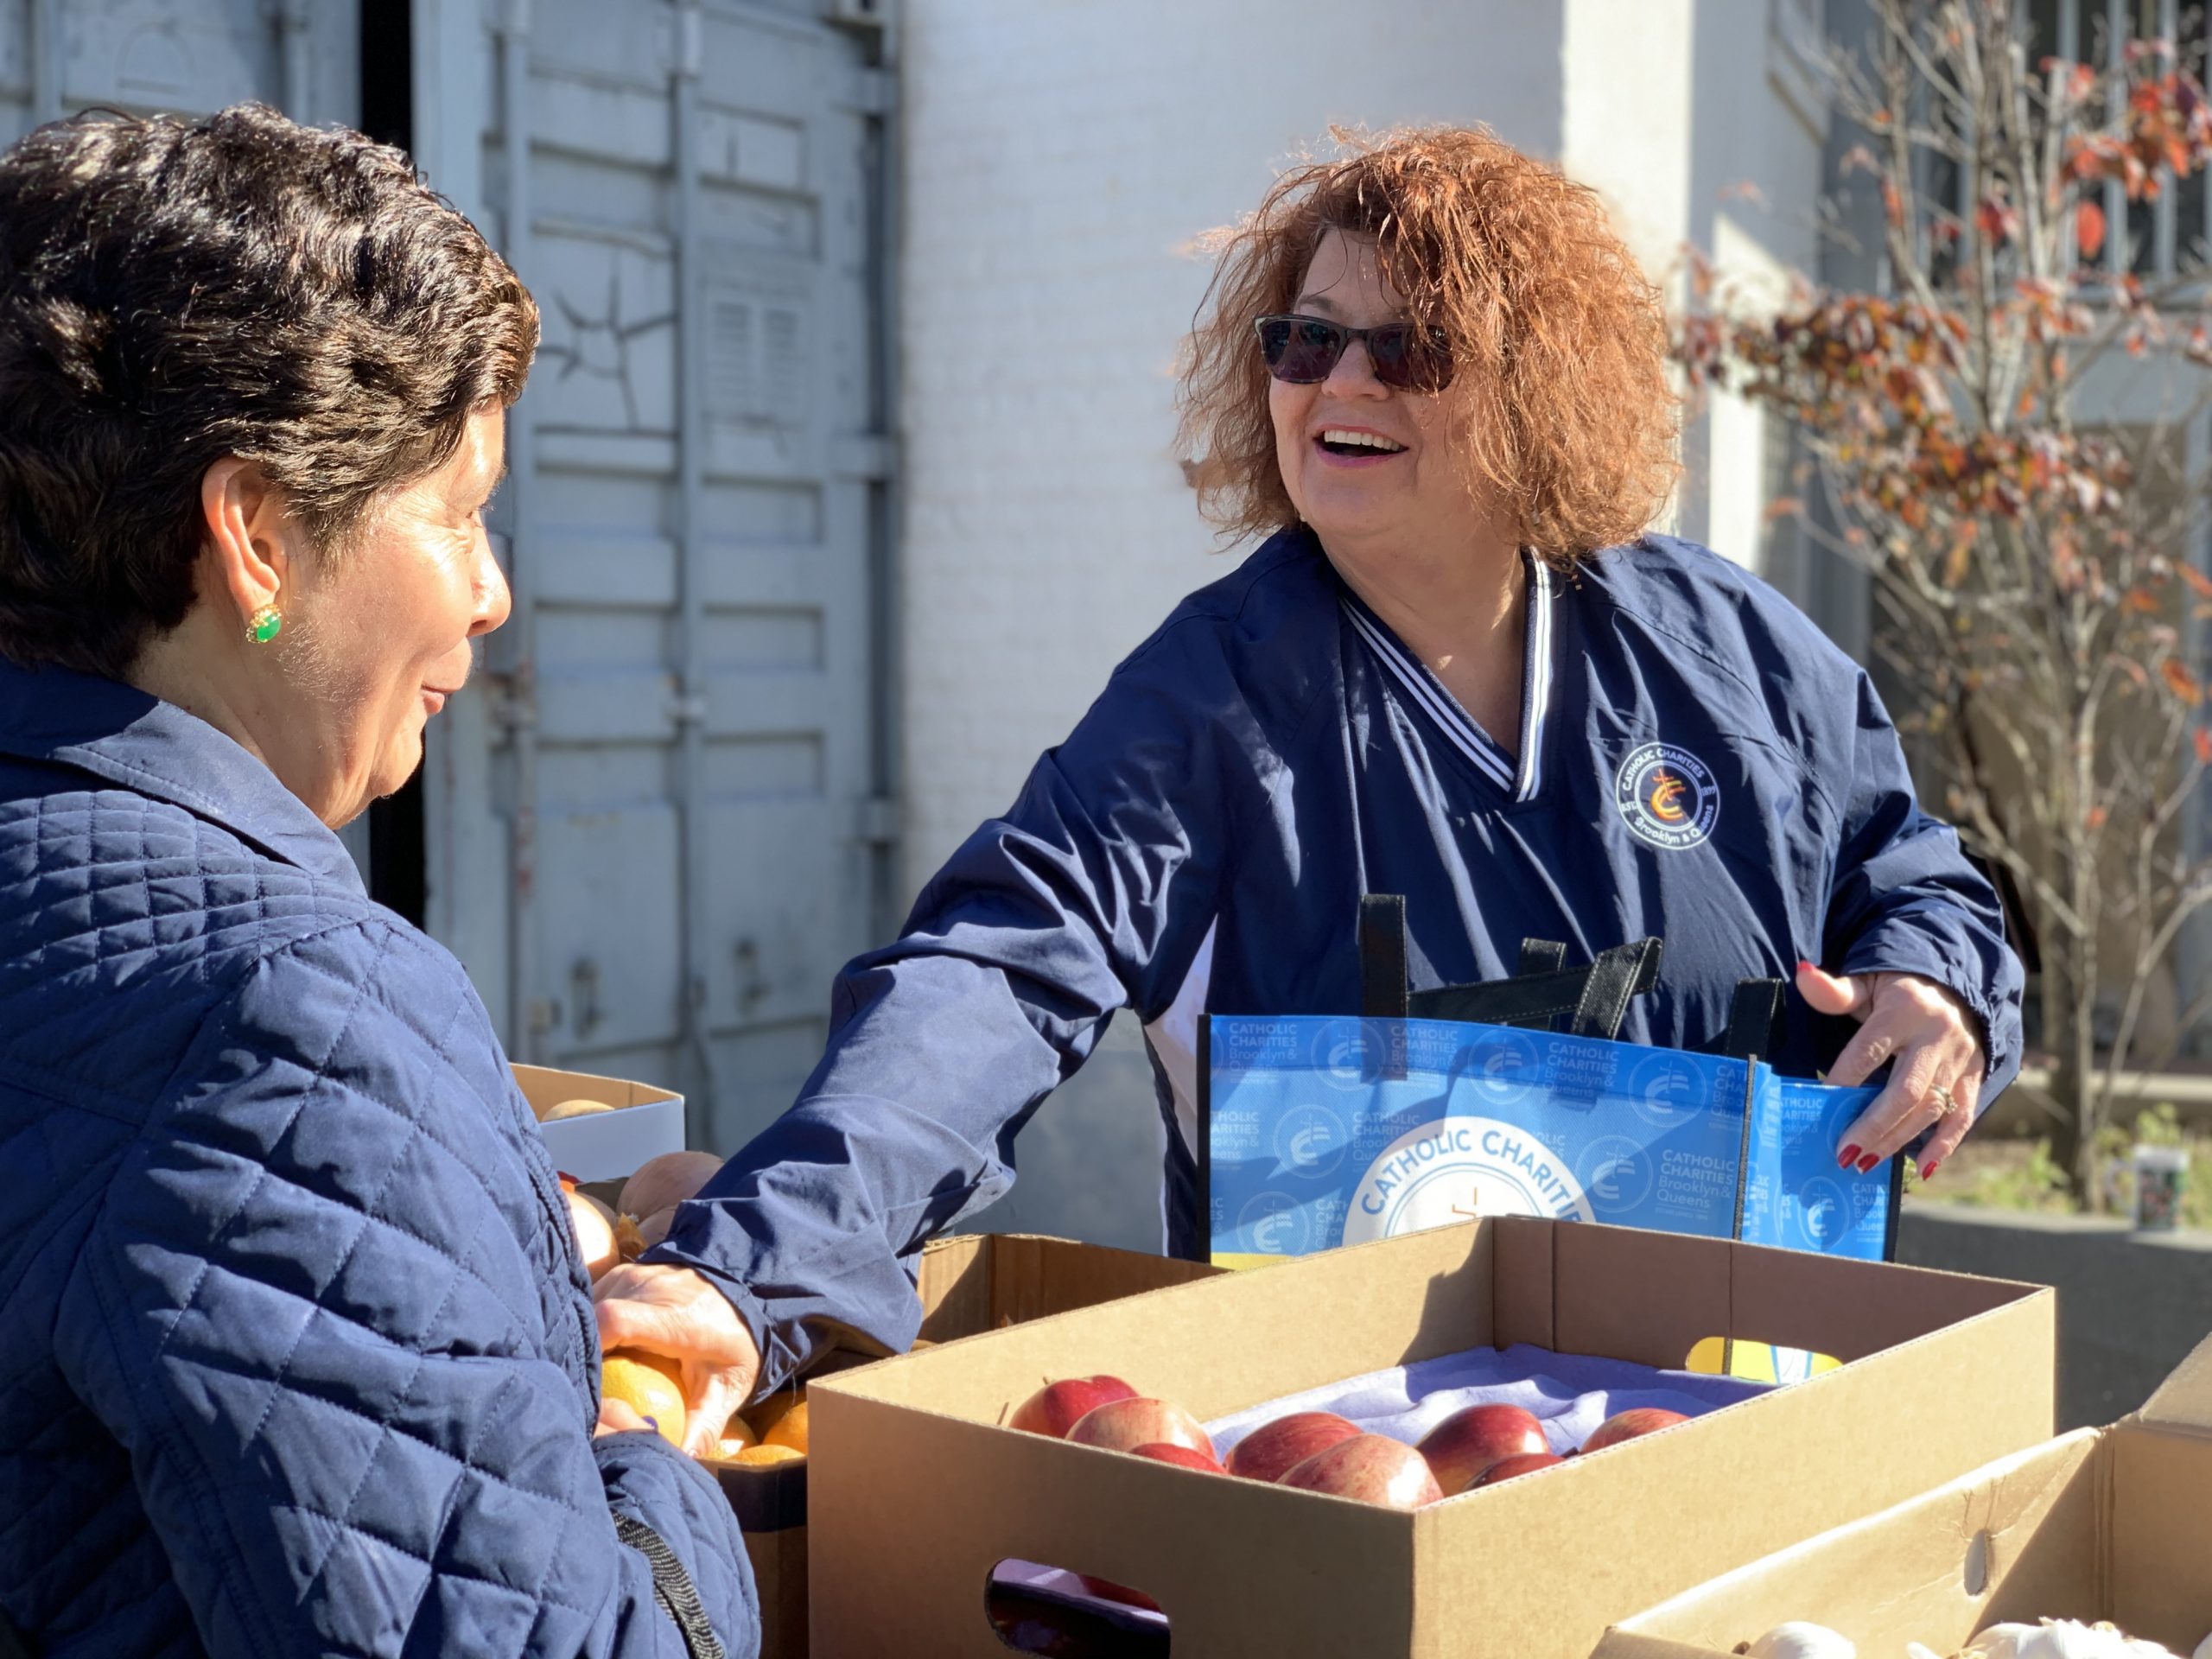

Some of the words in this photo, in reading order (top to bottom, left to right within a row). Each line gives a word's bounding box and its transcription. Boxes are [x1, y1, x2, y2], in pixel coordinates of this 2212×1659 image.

[1622, 749, 1656, 791] CATHOLIC
[1656, 747, 1706, 779] CHARITIES
[1634, 817, 1681, 844] Brooklyn
[1229, 1022, 1297, 1035] CATHOLIC
[1390, 1025, 1459, 1040] CATHOLIC
[1229, 1035, 1297, 1047] CHARITIES
[1390, 1038, 1458, 1053] CHARITIES
[1229, 1048, 1286, 1063] Brooklyn
[1287, 1048, 1297, 1059] &
[1548, 1041, 1620, 1062] CATHOLIC
[1547, 1054, 1618, 1074] CHARITIES
[1544, 1066, 1603, 1087] Brooklyn
[1604, 1075, 1615, 1087] &
[1352, 1111, 1421, 1125] CATHOLIC
[1662, 1148, 1735, 1172] CATHOLIC
[1361, 1129, 1471, 1215] CATHOLIC
[1660, 1162, 1734, 1185] CHARITIES
[1658, 1174, 1719, 1198] Brooklyn
[1720, 1185, 1732, 1198] &
[1656, 1188, 1711, 1208] Queens
